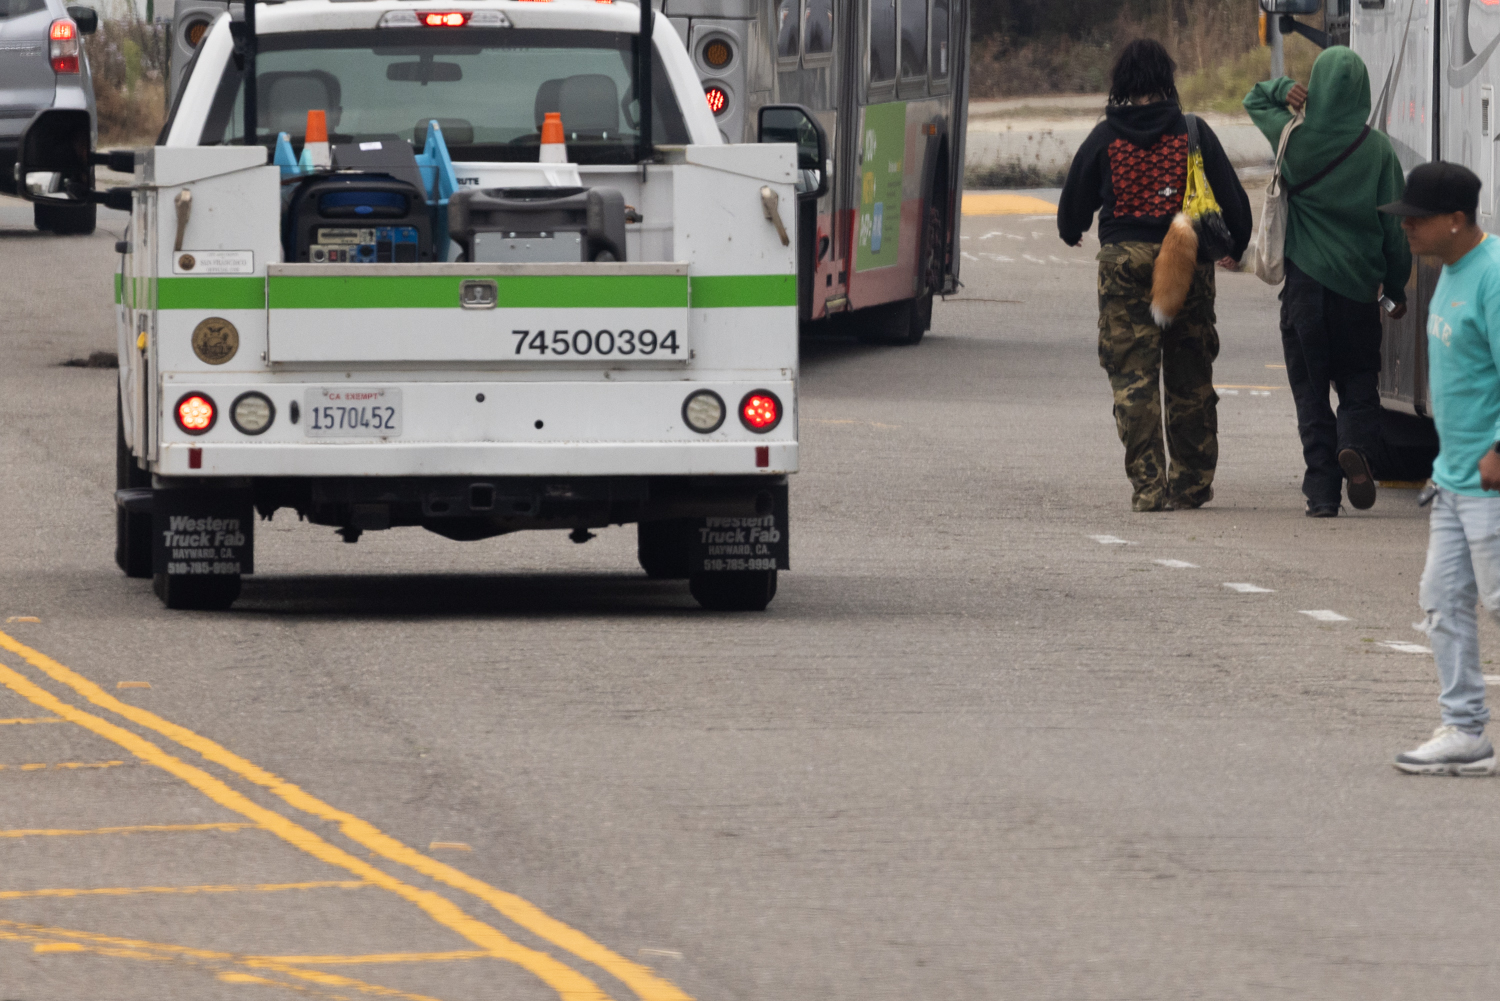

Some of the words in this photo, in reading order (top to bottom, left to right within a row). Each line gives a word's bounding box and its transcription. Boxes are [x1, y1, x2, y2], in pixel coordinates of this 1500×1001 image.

[456, 177, 479, 185] RUTE
[512, 329, 680, 355] 74500394
[311, 406, 396, 430] 1570452
[169, 515, 240, 531] Western
[163, 530, 211, 547] Truck
[214, 530, 245, 546] Fab
[699, 527, 746, 543] Truck
[749, 526, 780, 543] Fab
[172, 548, 218, 559] HAYWARD,
[708, 544, 753, 556] HAYWARD,
[704, 558, 776, 571] 510-785-9994
